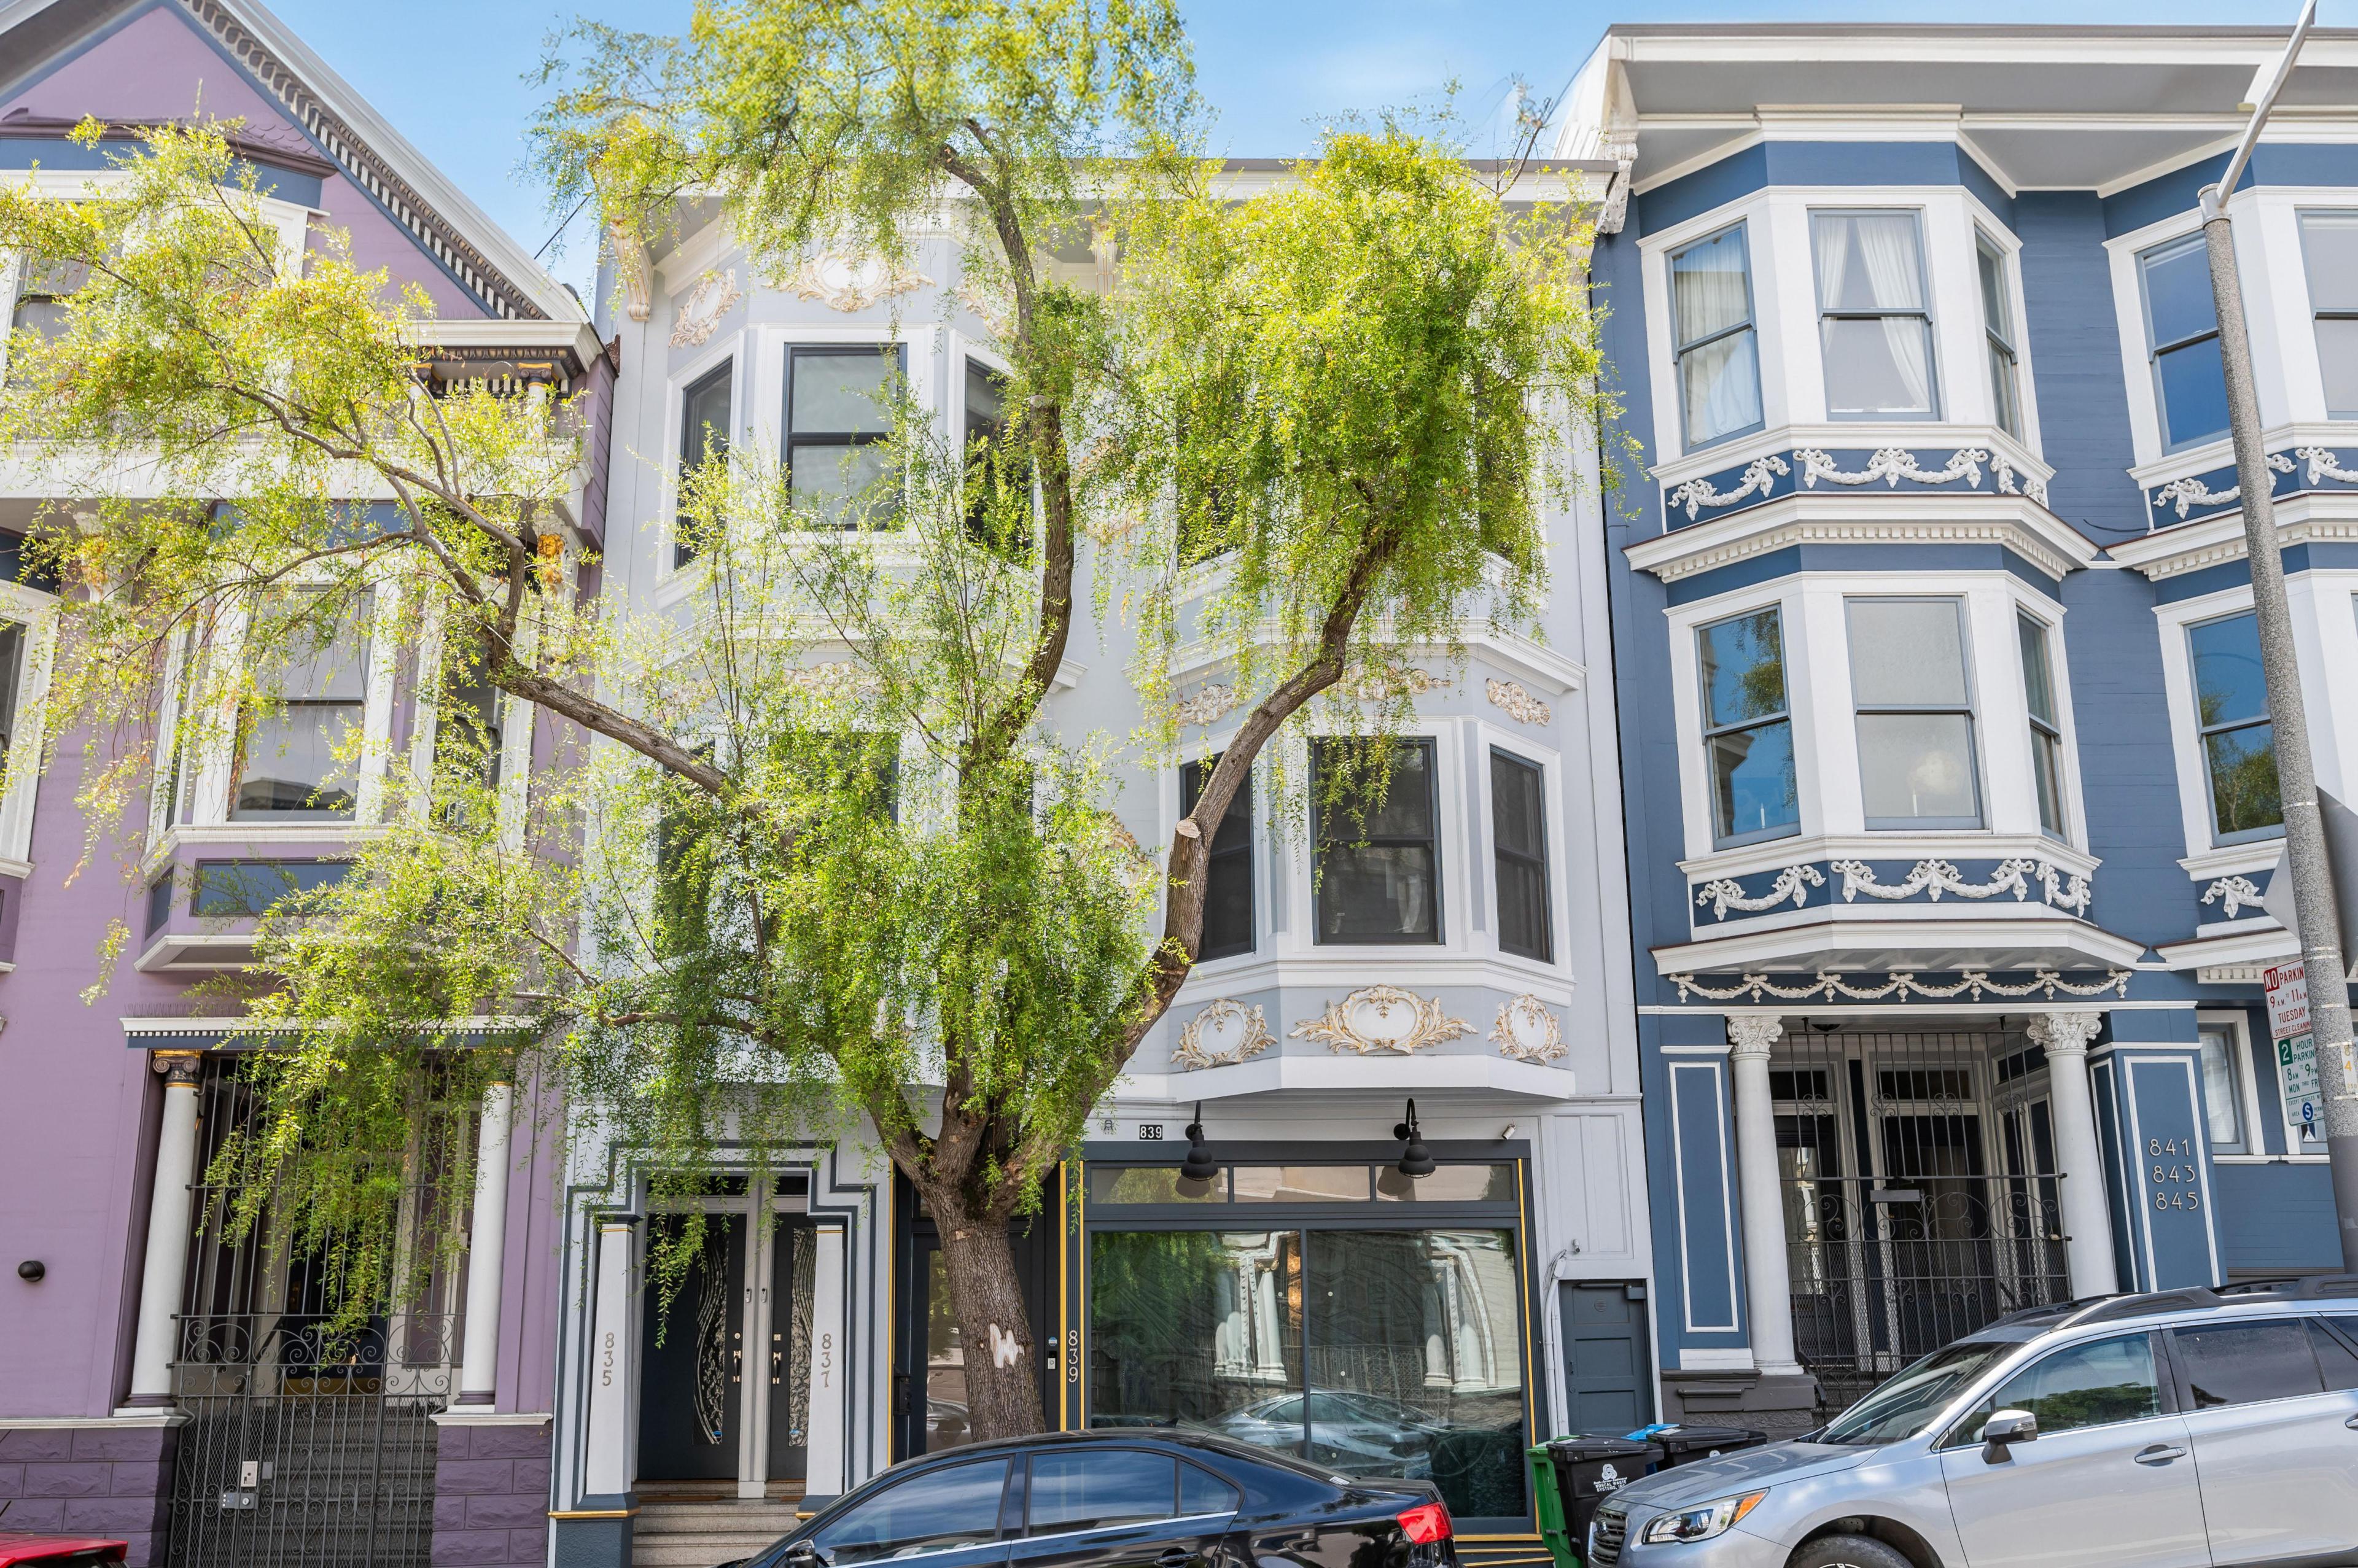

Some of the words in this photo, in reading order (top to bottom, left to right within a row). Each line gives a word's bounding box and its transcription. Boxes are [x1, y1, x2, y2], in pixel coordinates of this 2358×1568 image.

[2265, 970, 2278, 990] NO
[2279, 966, 2304, 985] PARKIN
[2270, 996, 2275, 1008] 9
[2278, 1006, 2305, 1023] TUESDAY
[2275, 1026, 2290, 1036] STREET
[2281, 1044, 2290, 1061] 2
[2297, 1038, 2313, 1050] HOUR
[2294, 1049, 2315, 1063] PARKIN
[2289, 1082, 2300, 1093] MON
[2305, 1104, 2311, 1118] S
[1140, 1126, 1162, 1139] 839
[2150, 1138, 2189, 1156] 841
[2153, 1165, 2195, 1183] 843
[2156, 1192, 2198, 1210] 845
[602, 1332, 615, 1387] 835
[820, 1333, 832, 1388] 837
[1068, 1330, 1078, 1383] 839
